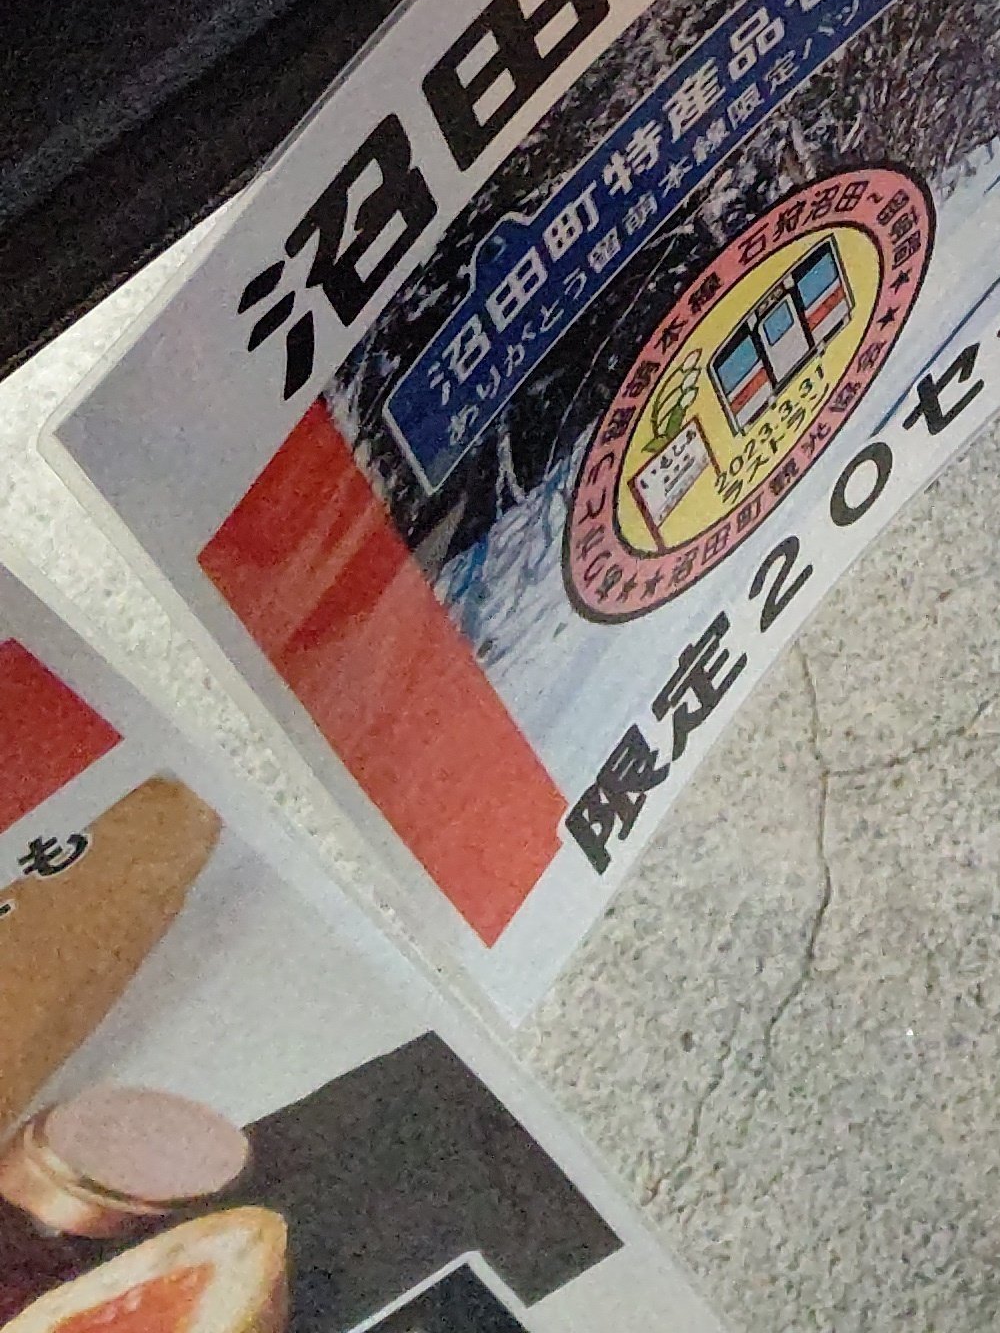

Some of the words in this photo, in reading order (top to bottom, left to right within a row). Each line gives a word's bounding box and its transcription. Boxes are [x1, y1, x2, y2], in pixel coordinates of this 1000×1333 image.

[715, 364, 825, 495] 2023.3.31
[721, 382, 831, 506] ラストラン
[17, 833, 89, 876] も
